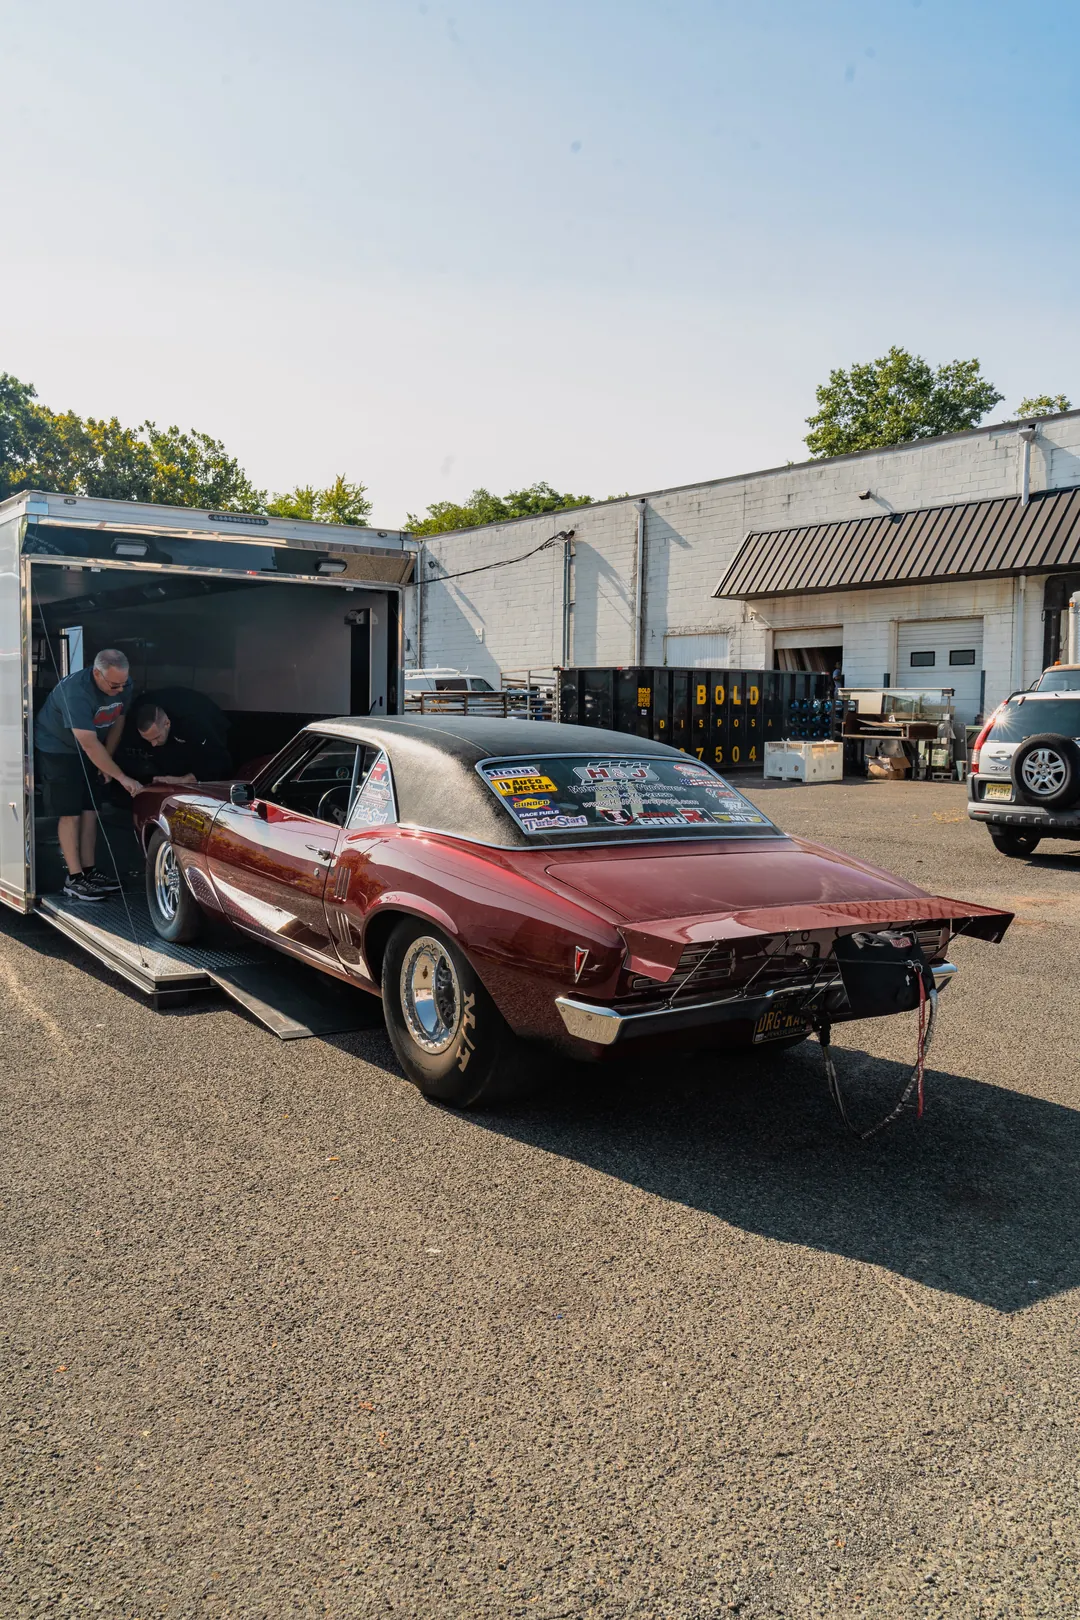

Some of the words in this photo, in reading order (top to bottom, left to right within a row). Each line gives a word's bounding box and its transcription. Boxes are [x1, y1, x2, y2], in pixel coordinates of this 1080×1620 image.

[697, 685, 759, 705] BOLD
[587, 769, 609, 778] H
[612, 768, 627, 778] &
[632, 769, 648, 778] J
[512, 778, 543, 786] Auto
[513, 784, 552, 793] Meter
[515, 800, 550, 808] SUNOCO
[639, 817, 687, 825] GRID
